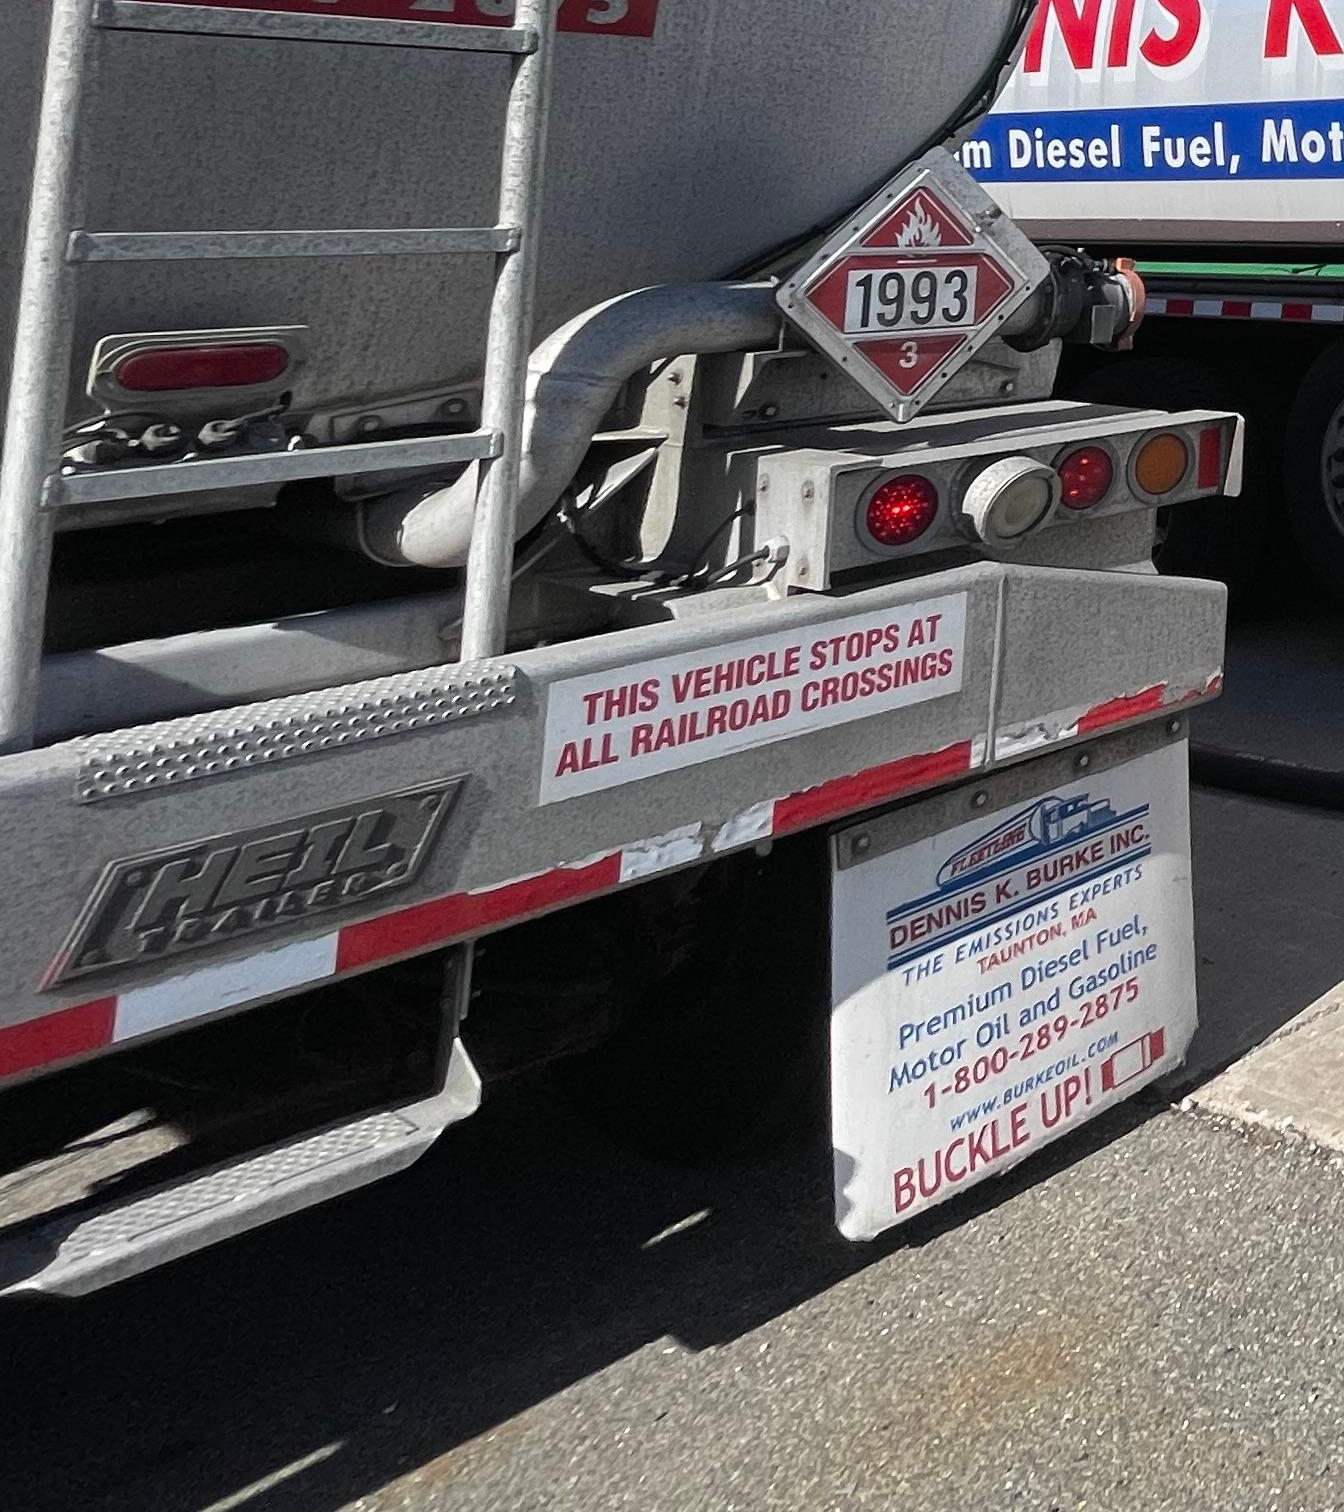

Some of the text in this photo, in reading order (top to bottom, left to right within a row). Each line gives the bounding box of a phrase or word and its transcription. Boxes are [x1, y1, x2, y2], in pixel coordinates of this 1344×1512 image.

[1009, 124, 1120, 168] Diesel
[1142, 121, 1241, 174] Fuel,
[854, 269, 970, 329] 1993
[899, 342, 918, 368] 3
[555, 648, 954, 777] ALL RAILROAD CROSSINGS
[582, 614, 942, 725] THIS VEHICLE STOPS AT
[127, 808, 394, 931] HEIL
[890, 824, 1150, 950] DENNIS K. BURKE INC.
[902, 863, 1143, 986] THE EMISSIONS EXPERTS
[899, 914, 1147, 1050] Premium Diesel Fuel,
[977, 908, 1098, 975] TAUNTON, MA
[889, 943, 1157, 1095] Motor Oil and Gasoline
[924, 976, 1139, 1109] 1-800-289-2875
[894, 1068, 1092, 1214] BUCKLE UP!
